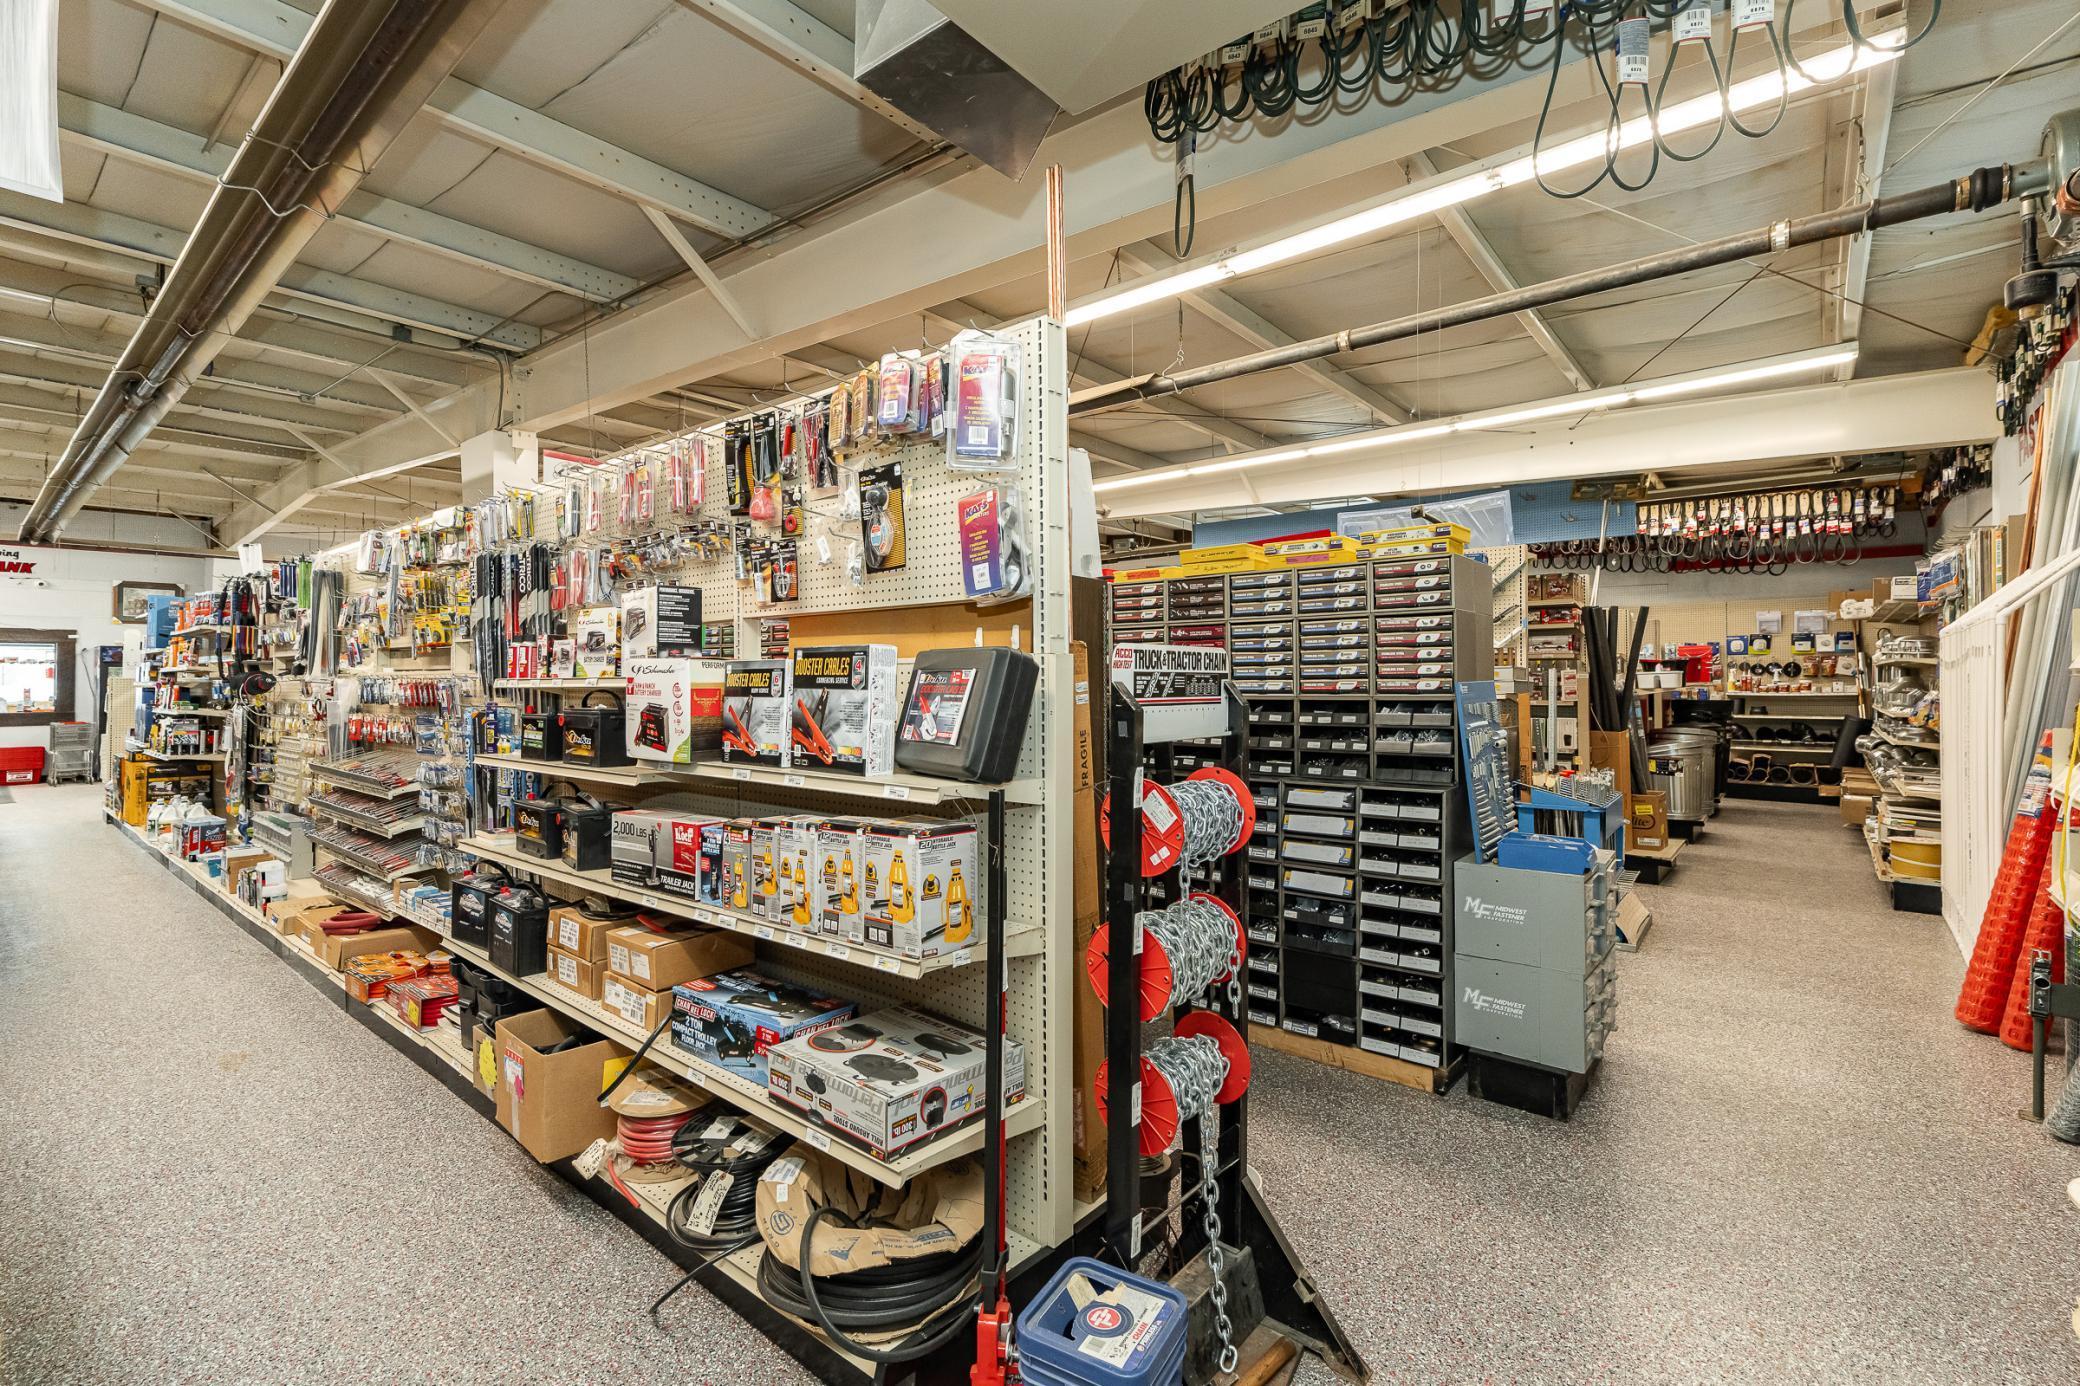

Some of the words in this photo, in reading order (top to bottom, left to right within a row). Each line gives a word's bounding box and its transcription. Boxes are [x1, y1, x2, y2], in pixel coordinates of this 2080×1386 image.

[1115, 648, 1133, 659] ACCO
[1133, 649, 1162, 670] TRUCK
[1166, 650, 1202, 671] TRACTOR
[1203, 652, 1227, 671] CHAIN
[795, 657, 822, 676] BOOSTER
[823, 657, 850, 676] CABLES
[855, 659, 862, 672] 4
[726, 672, 748, 687] BOOSTER
[748, 672, 771, 687] CABLES
[1080, 729, 1089, 787] FRAGILE
[613, 820, 635, 836] 2,000
[635, 827, 648, 838] LBS
[660, 874, 682, 888] TRAILER
[681, 880, 695, 890] JACK
[1493, 911, 1525, 921] FASTENER
[1494, 905, 1528, 915] MIDWEST
[1492, 1003, 1524, 1015] FASTENER
[1493, 997, 1527, 1010] MIDWEST
[691, 1017, 703, 1031] TON
[671, 1020, 694, 1037] COMPACT
[694, 1031, 717, 1047] TROLLEY
[681, 1033, 695, 1046] FLOOR
[695, 1040, 706, 1051] JACK
[833, 1114, 849, 1128] STOOL
[901, 1121, 913, 1134] 300
[1132, 1321, 1149, 1341] CHAIN
